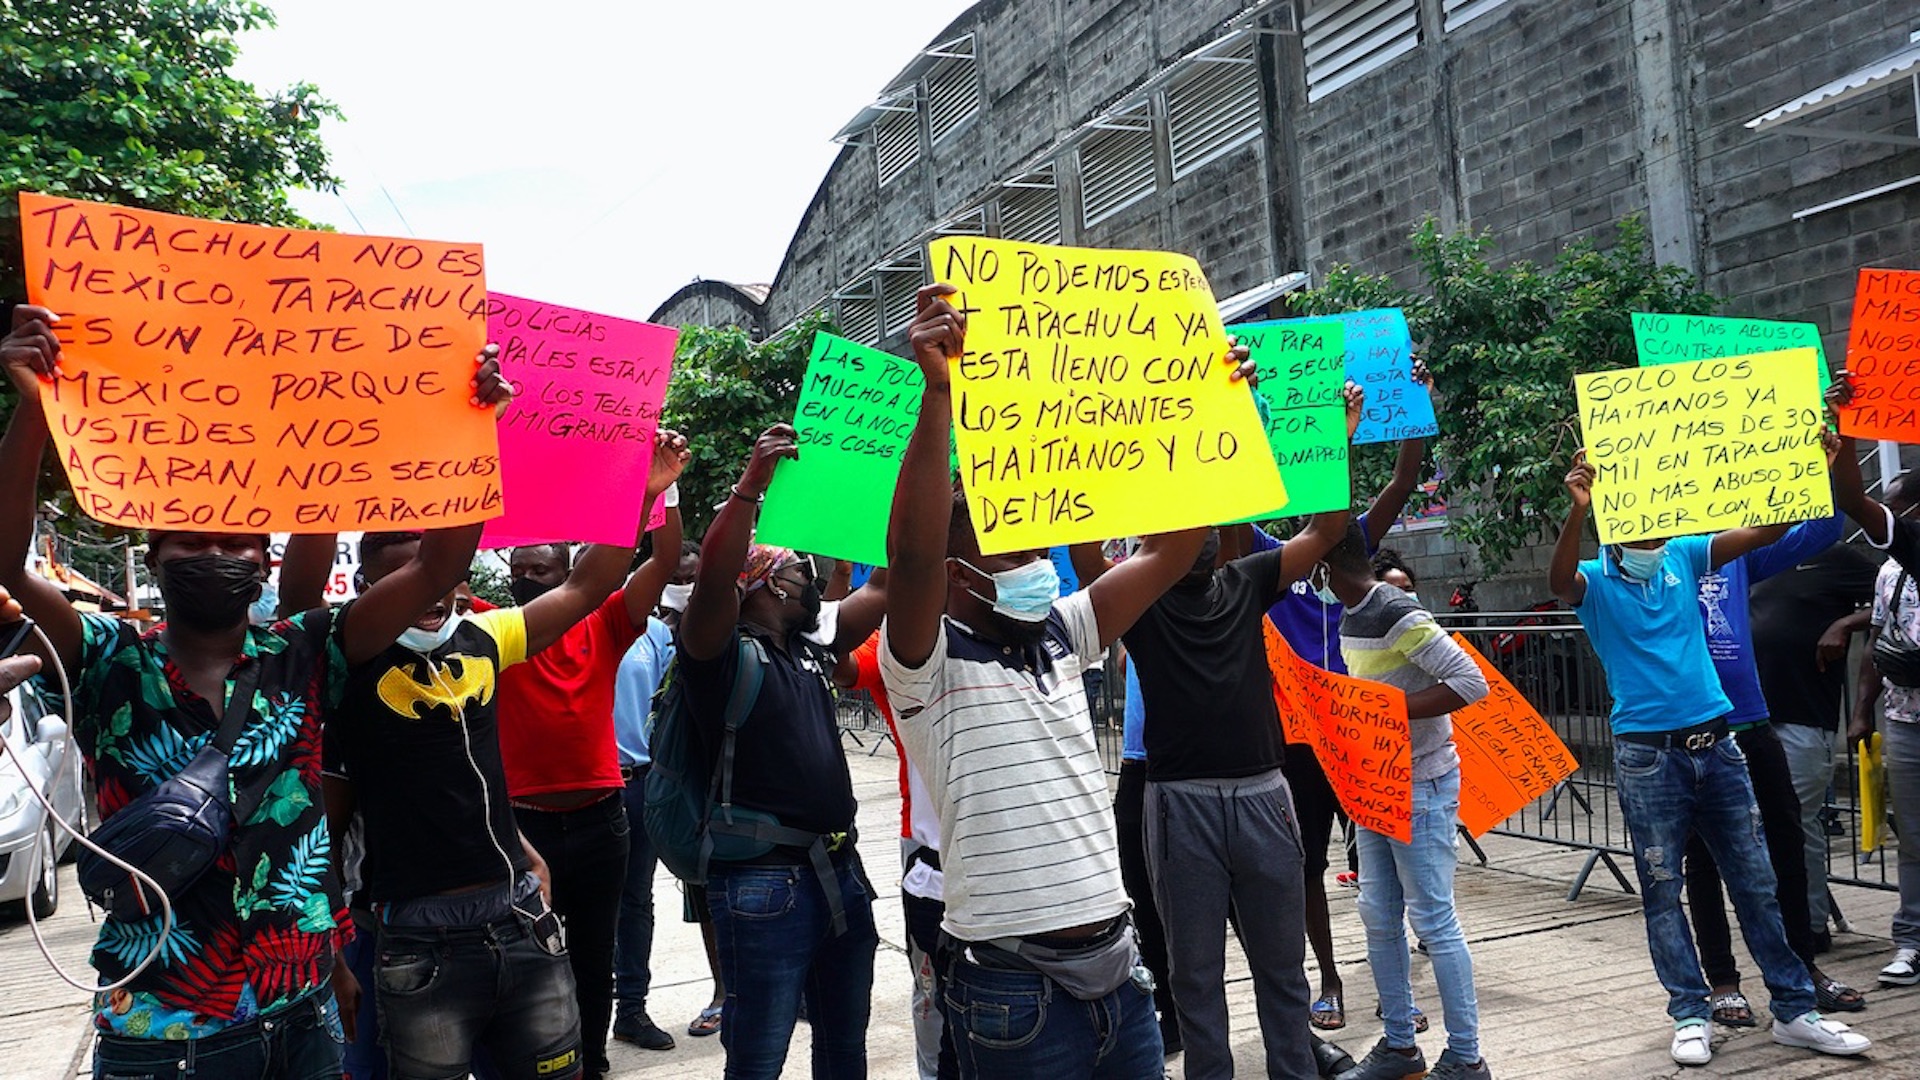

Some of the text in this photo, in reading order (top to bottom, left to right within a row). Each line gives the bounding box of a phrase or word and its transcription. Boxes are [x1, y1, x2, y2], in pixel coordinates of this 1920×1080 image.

[32, 203, 484, 278] TAPACHULA NO ES
[946, 244, 999, 284] NO
[1017, 250, 1150, 296] PODEMOS
[268, 277, 488, 322] TAPACHULA
[51, 313, 452, 357] ES UN PARTE DE
[1000, 301, 1156, 341] TAPACHULA
[1175, 312, 1210, 346] YA
[1281, 329, 1323, 352] PARA
[1638, 317, 1805, 340] NO MAS ABUSO
[819, 339, 865, 372] LAS
[1367, 346, 1400, 366] HAY
[1643, 338, 1726, 359] CONTRA
[1734, 342, 1763, 356] LOS
[1855, 355, 1920, 378] QUE
[960, 350, 1031, 381] ESTA
[1144, 352, 1214, 384] CON
[1365, 369, 1406, 383] ESTA
[1587, 360, 1753, 402] SOLO LOS
[271, 371, 446, 411] PORQUE
[541, 381, 584, 406] LOS
[810, 372, 884, 403] MUCHO
[886, 394, 900, 410] A
[1376, 388, 1403, 402] DE
[802, 401, 839, 420] EN
[844, 405, 863, 427] LA
[961, 391, 1021, 432] LOS
[1270, 416, 1322, 438] FOR
[1851, 404, 1916, 430] TAPA
[63, 413, 380, 450] USTEDES NOS
[798, 427, 834, 446] SUS
[840, 435, 896, 459] COSAS
[1595, 429, 1656, 459] SON
[1740, 413, 1775, 435] DE
[1783, 408, 1818, 429] 30
[1157, 435, 1176, 472] Y
[1196, 430, 1238, 464] LO
[1657, 450, 1689, 472] EN
[277, 460, 372, 490] NOS
[390, 454, 498, 481] SECUES
[1602, 492, 1637, 514] NO
[1713, 469, 1782, 493] ABUSO
[1788, 461, 1824, 482] DE
[296, 503, 338, 523] EN
[357, 485, 502, 523] TAPACHULA
[977, 489, 1095, 533] DEMAS
[1606, 486, 1811, 539] PODER CON LOS
[1488, 680, 1521, 712] ASK
[1336, 724, 1361, 741] NO
[1373, 736, 1406, 760] HAY
